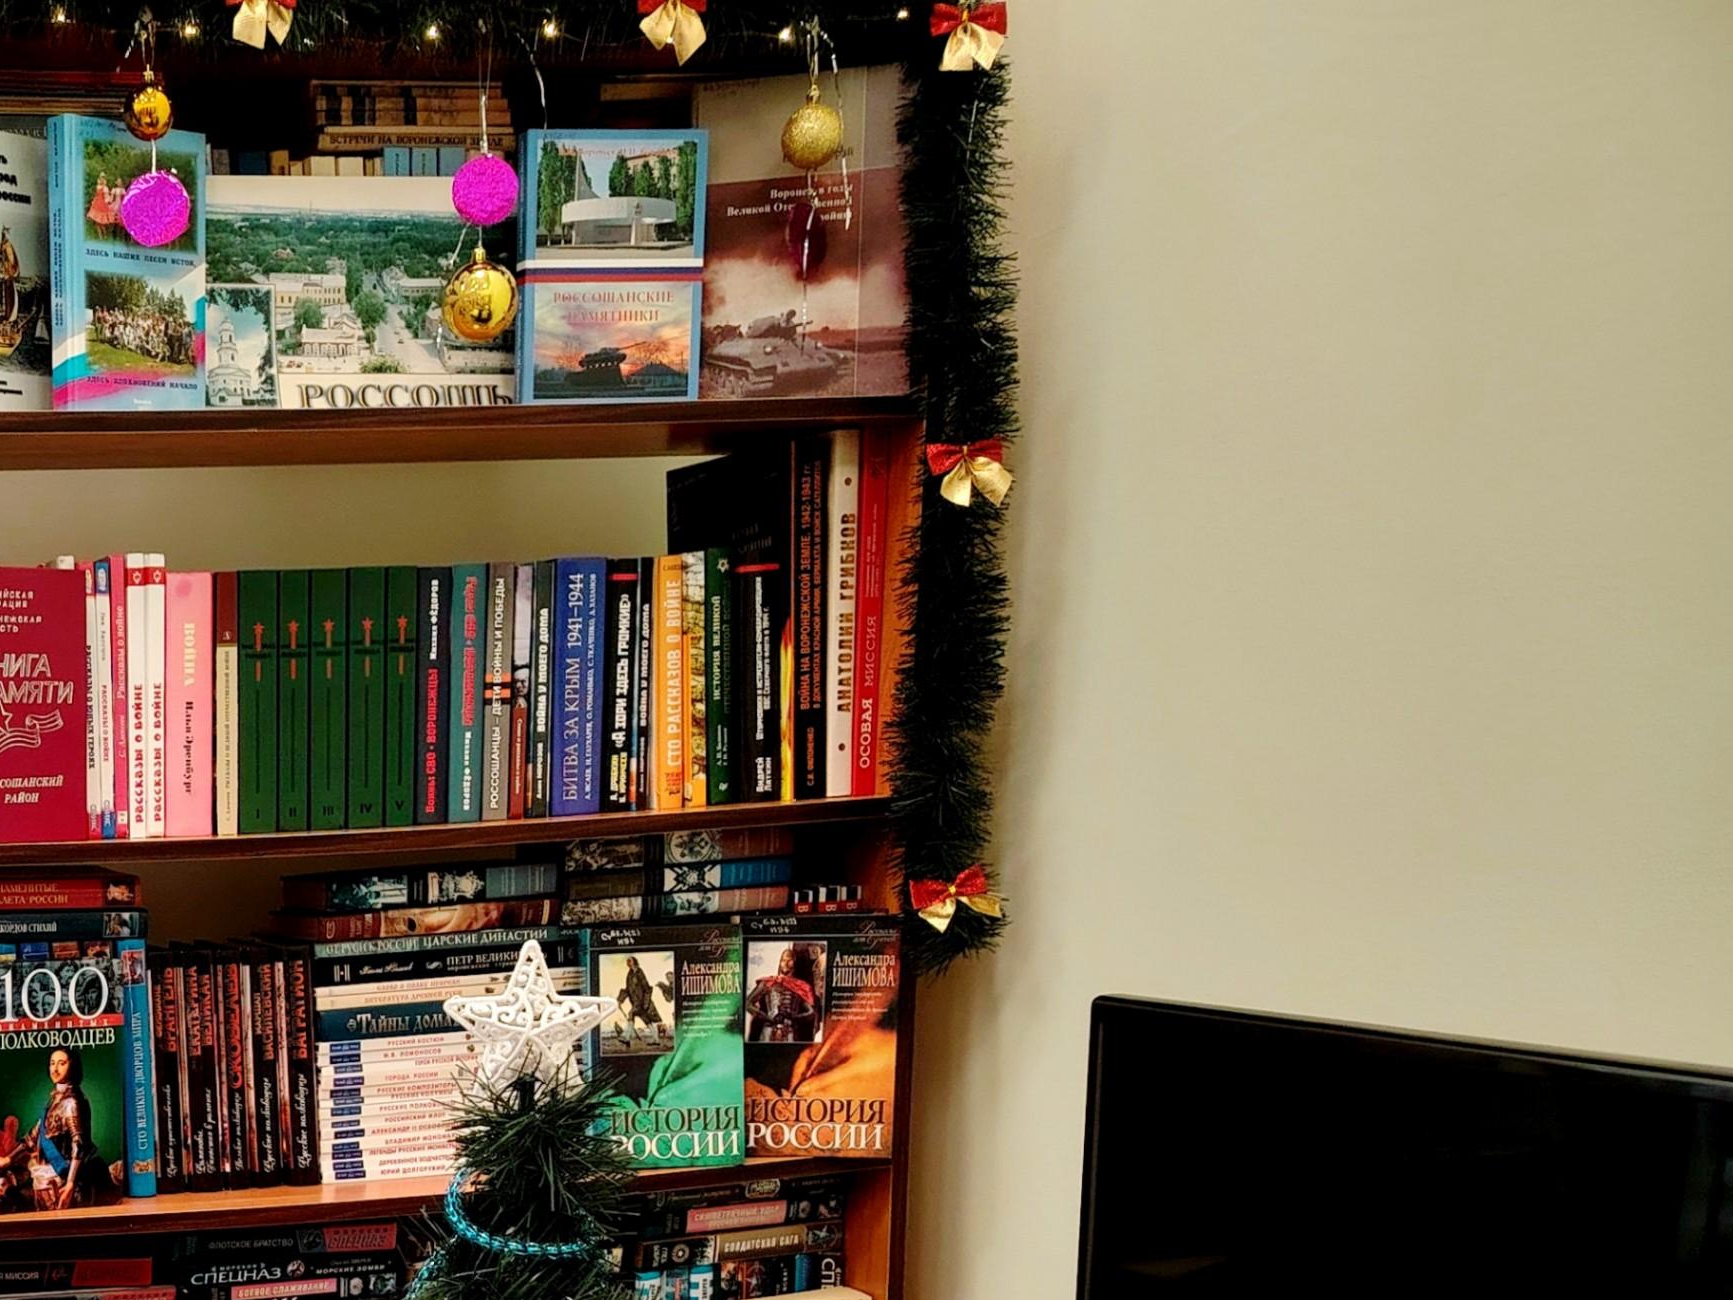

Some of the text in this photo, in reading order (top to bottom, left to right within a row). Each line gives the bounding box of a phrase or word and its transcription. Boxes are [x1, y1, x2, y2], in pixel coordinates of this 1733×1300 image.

[799, 574, 811, 654] ВОРОНЕЖСКОЙ
[836, 513, 856, 713] АНАТОЛИЙ ГРИБКОВ
[184, 622, 195, 686] ВОЙНА
[665, 580, 681, 766] СТО РАССКАЗОВ О ВОЙНЕ
[800, 658, 810, 672] НА
[490, 578, 505, 808] РОССОШАНЦЫ ДЕТИ ВОЙНЫ ПОБЕДЫ
[564, 658, 580, 711] КРЫМ
[799, 675, 810, 710] ВОЙНА
[859, 616, 877, 769] ОСОБАЯ МИССИЯ
[563, 717, 579, 739] ЗА
[562, 743, 579, 800] БИТВА
[4, 793, 39, 803] РАЙОН
[423, 929, 548, 948] ЦАРСКИЕ ДИНАСТИИ
[681, 960, 740, 975] Александра
[681, 975, 741, 996] ИШИМОВА
[832, 966, 895, 987] ИШИМОВА
[0, 966, 108, 1022] 100
[290, 960, 308, 1059] БАГРАТИОН
[131, 1011, 148, 1149] СТО ВЕЛИКИХ ДВОРЦОВ МИРА
[748, 1097, 885, 1123] ИСТОРИЯ
[747, 1121, 884, 1150] РОССИИ
[190, 1266, 281, 1286] СПЕЦНАЗ
